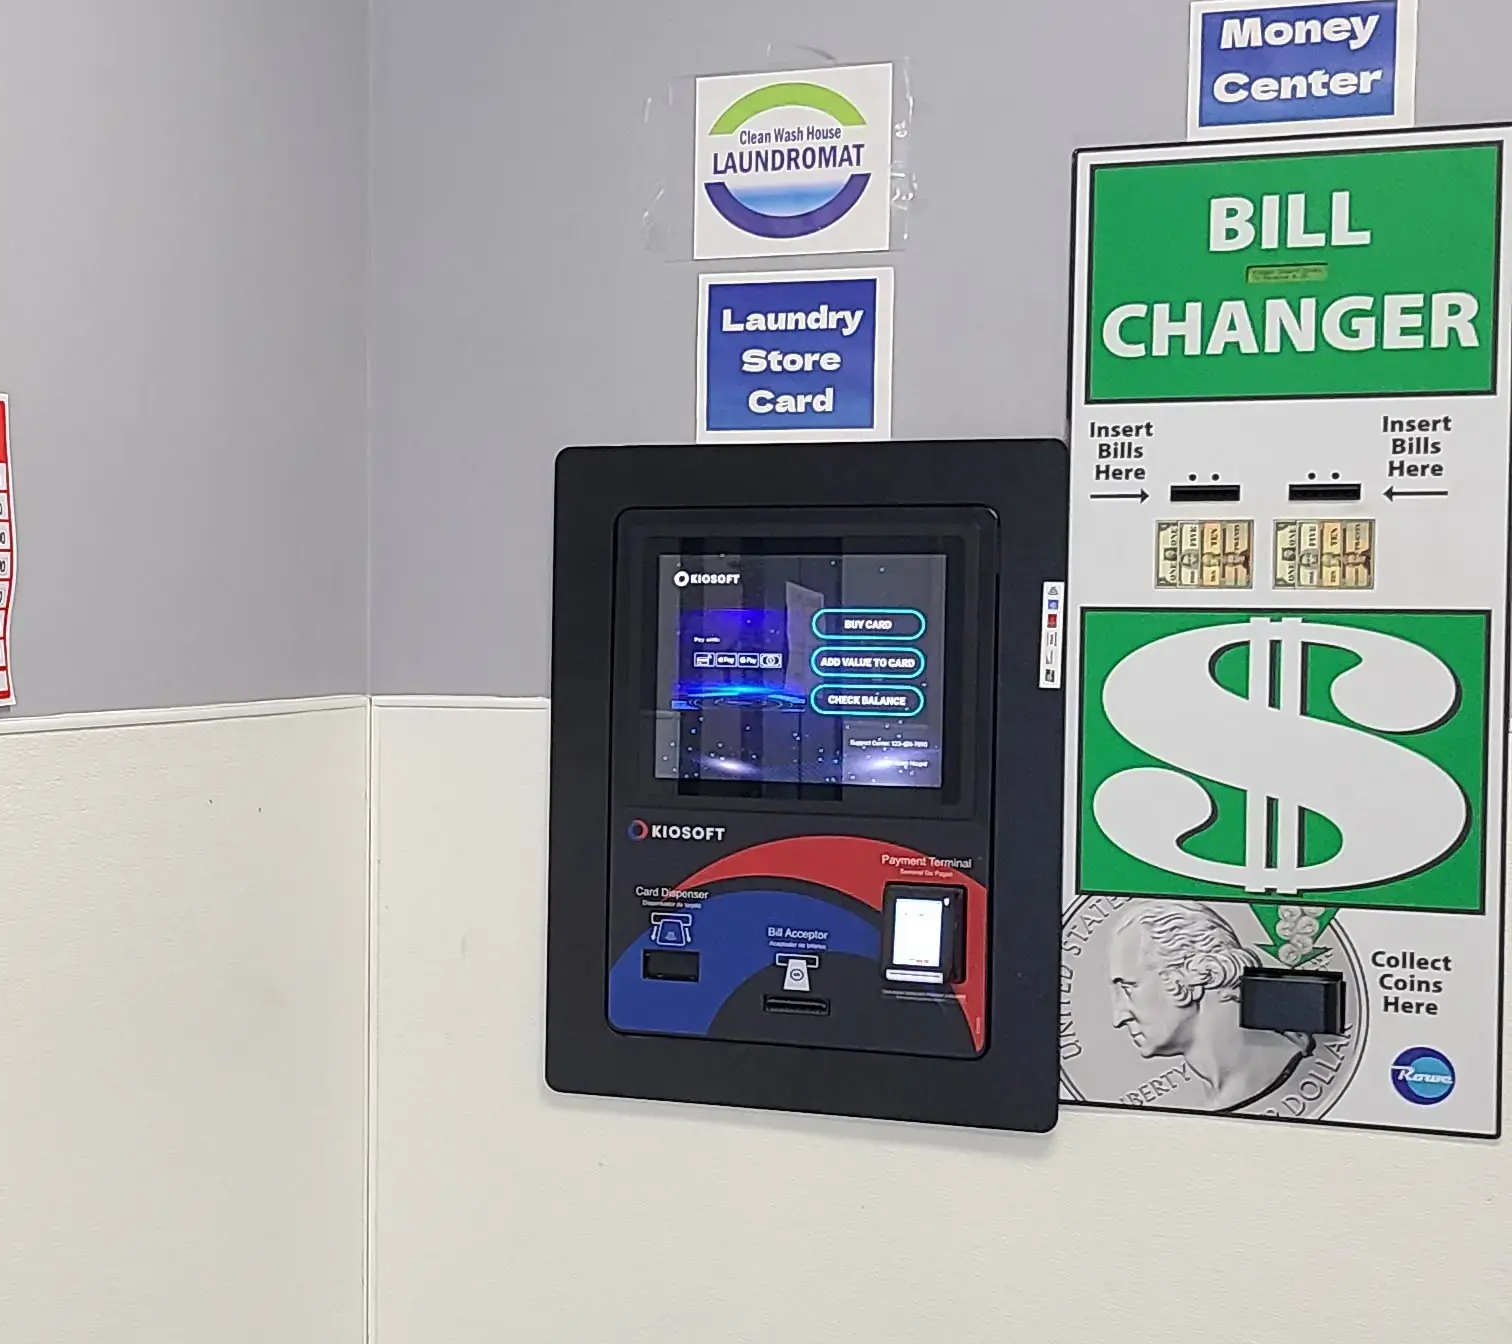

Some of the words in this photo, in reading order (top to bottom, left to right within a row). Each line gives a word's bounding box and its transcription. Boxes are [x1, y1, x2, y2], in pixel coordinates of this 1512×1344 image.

[1220, 14, 1379, 51] Money
[1214, 68, 1383, 103] Center
[739, 130, 771, 145] Clean
[773, 127, 803, 143] Wash
[806, 125, 842, 141] House
[712, 144, 865, 175] LAUNDROMAT
[1208, 191, 1371, 253] BILL
[722, 304, 863, 336] Laundry
[1102, 292, 1480, 358] CHANGER
[741, 349, 842, 373] Store
[748, 387, 835, 414] Card
[1090, 421, 1154, 438] Insert
[1382, 415, 1452, 433] Insert
[1098, 443, 1144, 459] Bills
[1391, 437, 1442, 455] Bills
[1095, 464, 1146, 481] Here
[1388, 459, 1444, 478] Here
[690, 573, 740, 584] KIOSOFT
[844, 619, 865, 629] BUY
[865, 620, 892, 629] CARD
[820, 657, 841, 666] ADD
[842, 658, 872, 667] VALUE
[873, 658, 888, 667] TO
[888, 658, 915, 668] CARD
[828, 695, 861, 705] CHECK
[861, 696, 907, 706] BALANCE
[651, 824, 725, 841] KIOSOFT
[881, 855, 927, 867] Payment
[929, 857, 973, 869] Terminal
[635, 886, 659, 897] Card
[661, 887, 709, 900] Dispenser
[768, 926, 783, 937] Bill
[785, 927, 829, 941] Acceptor
[1371, 950, 1452, 972] Collect
[1378, 973, 1443, 994] Coins
[1382, 995, 1439, 1015] Here
[1391, 1064, 1453, 1085] Rowe
